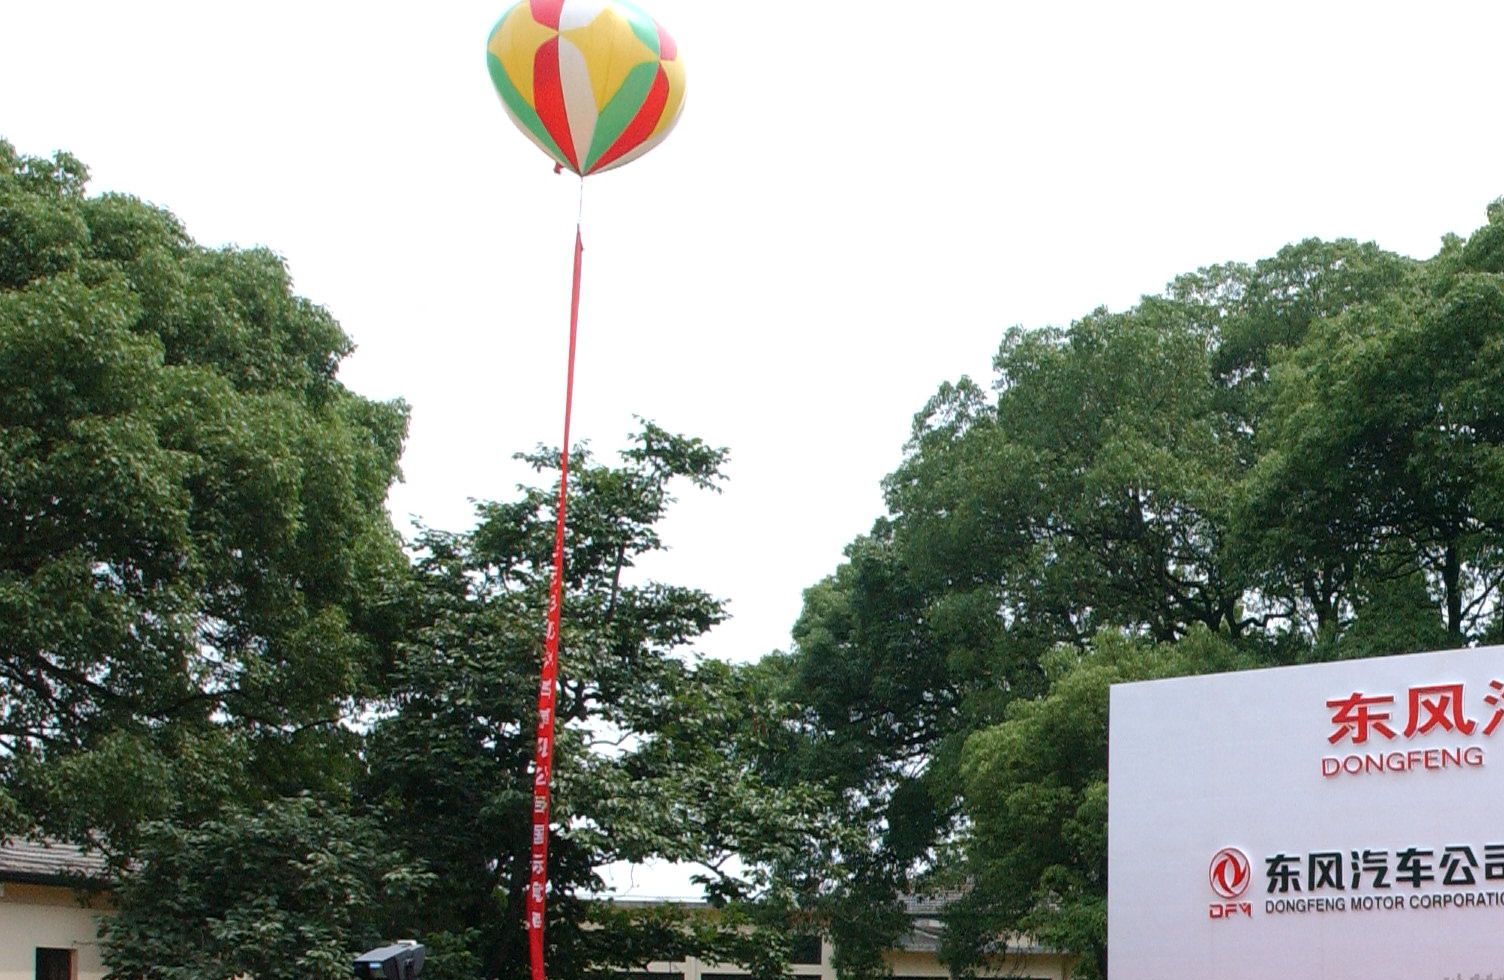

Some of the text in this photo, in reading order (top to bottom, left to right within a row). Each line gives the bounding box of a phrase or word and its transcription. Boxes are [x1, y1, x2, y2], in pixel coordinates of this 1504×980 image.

[1321, 746, 1484, 777] DONGFENG
[1265, 897, 1345, 913] DONGFENG
[1351, 895, 1405, 910] MOTOR
